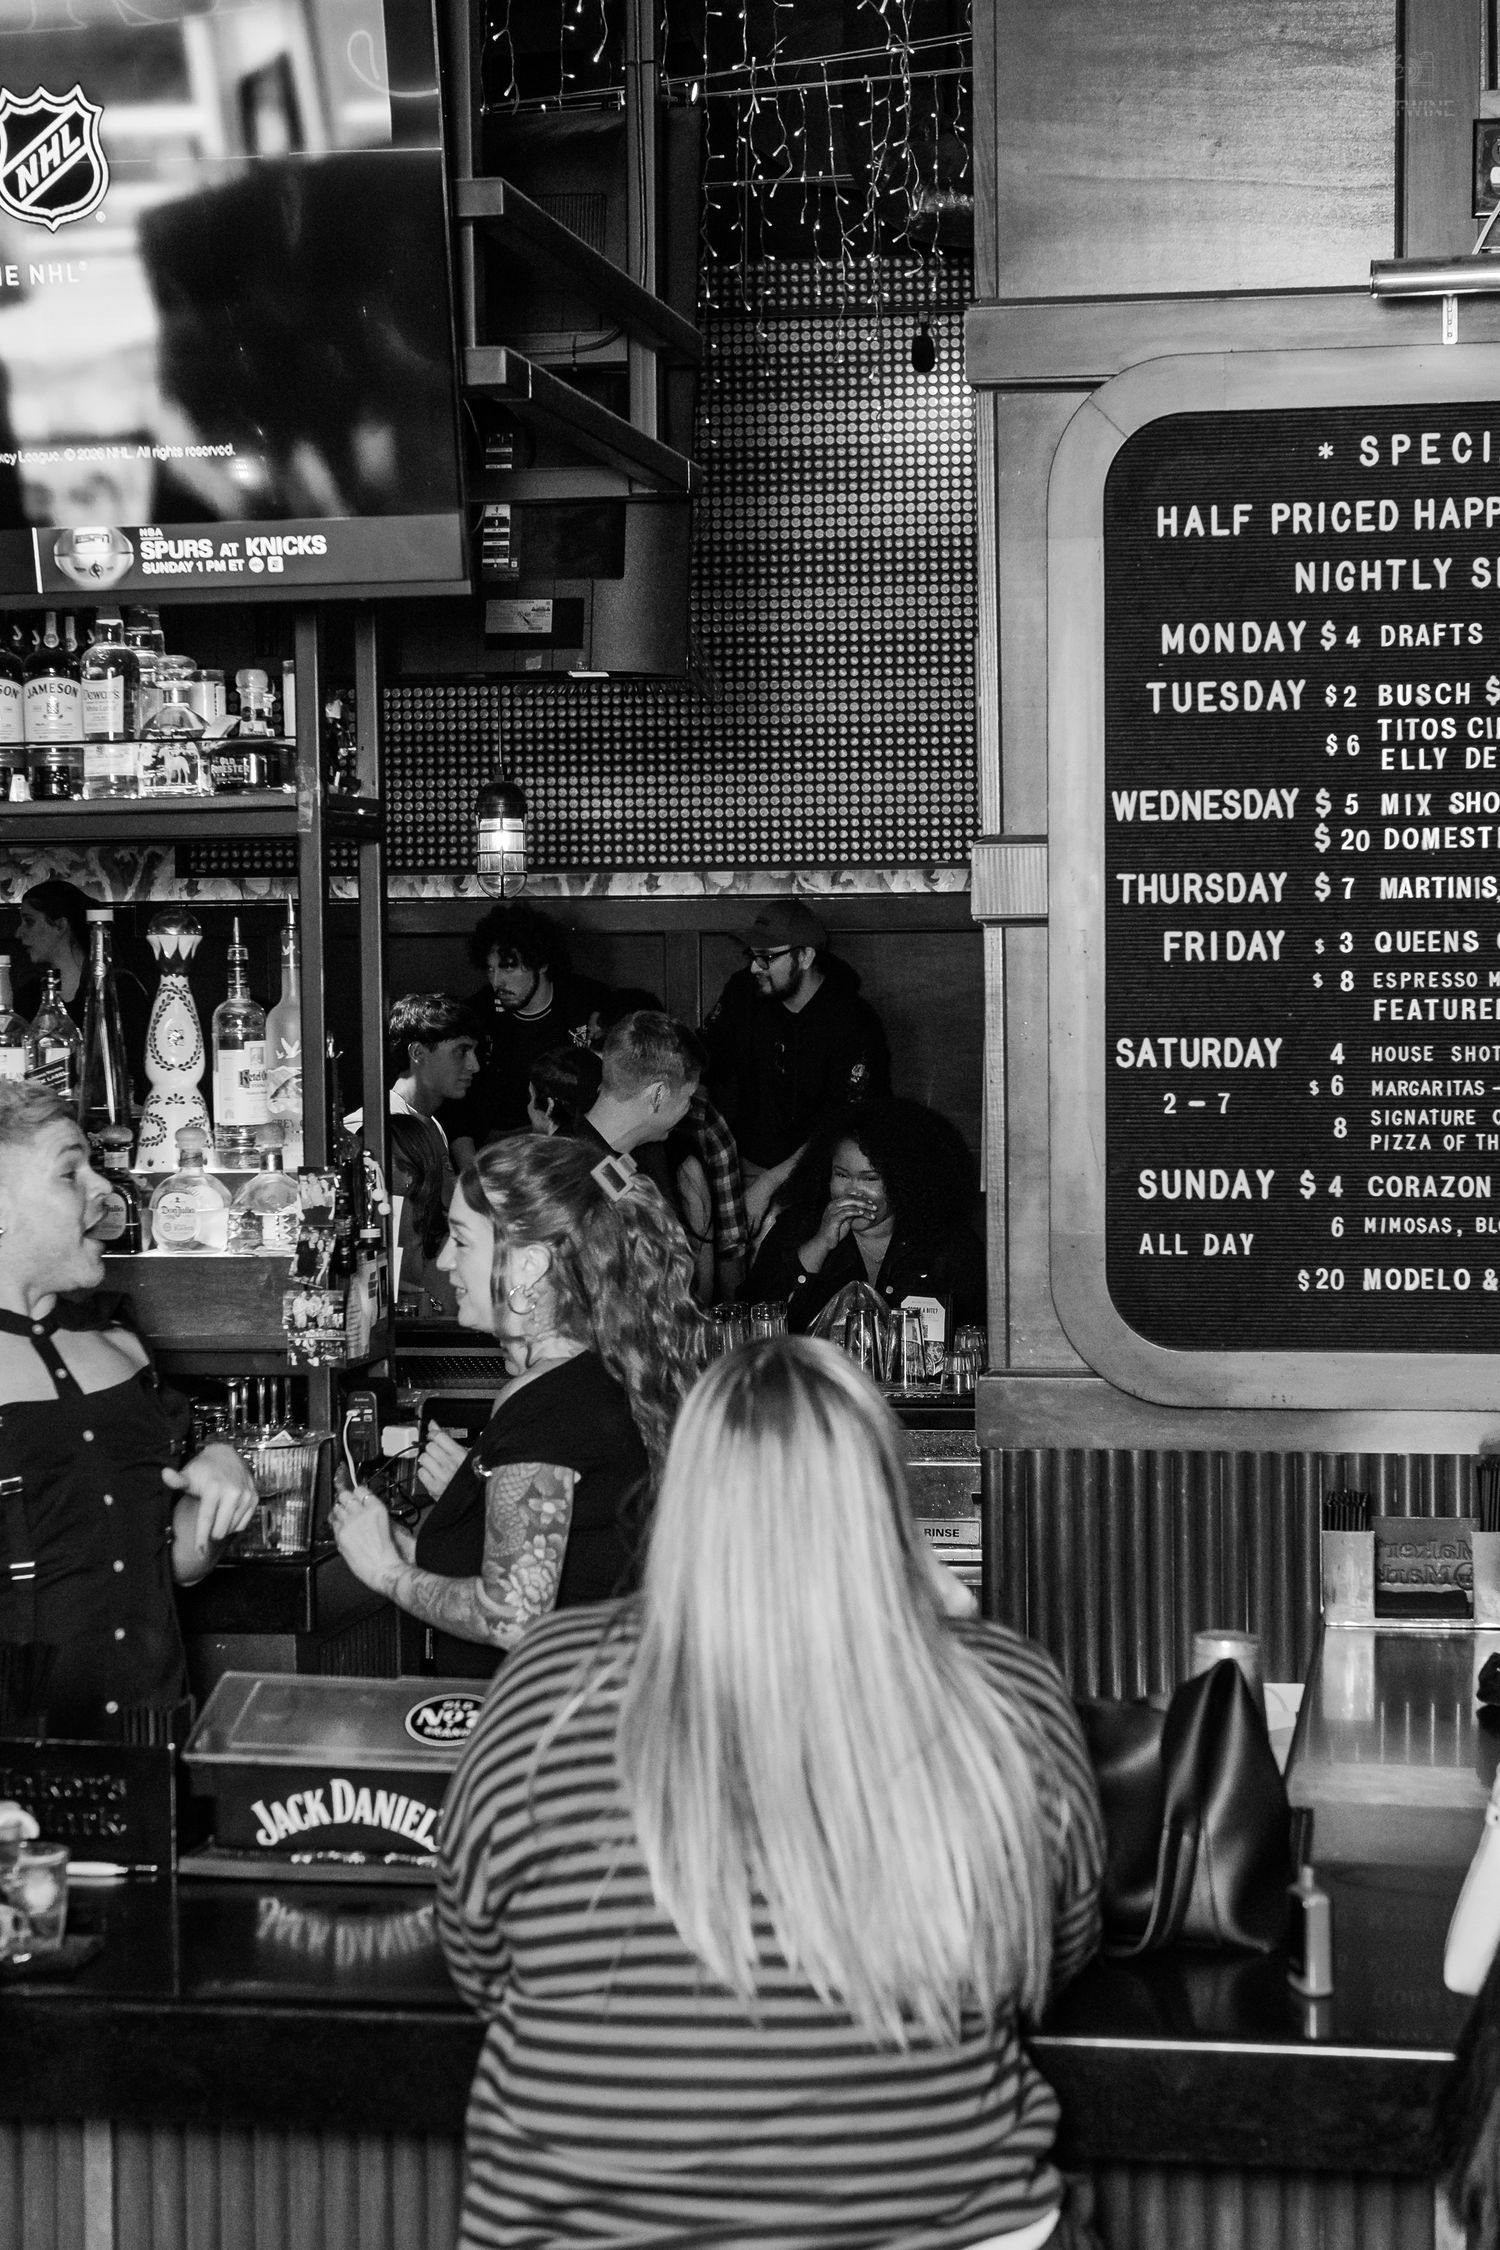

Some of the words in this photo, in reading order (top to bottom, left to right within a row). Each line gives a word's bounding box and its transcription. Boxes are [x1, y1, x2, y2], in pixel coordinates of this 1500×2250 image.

[15, 123, 81, 198] NHL
[136, 445, 151, 458] All
[152, 444, 184, 461] rights
[1360, 431, 1490, 467] SPECI
[1158, 504, 1252, 538] HALF
[1272, 500, 1399, 535] PRICED
[1415, 497, 1500, 530] HAPP
[139, 528, 163, 537] NBA
[140, 538, 213, 560] SPURS
[219, 542, 239, 557] AT
[245, 535, 328, 556] KNICKS
[142, 560, 194, 574] SUNDAY
[196, 560, 203, 572] 1
[205, 559, 227, 572] PM
[228, 559, 245, 572] ET
[1295, 558, 1452, 593] NIGHTLY
[1471, 557, 1500, 588] S
[1162, 620, 1306, 654] MONDAY
[1381, 623, 1483, 647] DRAFTS
[27, 683, 79, 699] JAMESON
[1146, 679, 1305, 714] TUESDAY
[1379, 682, 1470, 706] BUSCH
[1377, 718, 1456, 741] TITOS
[1382, 747, 1447, 770] ELLY
[1466, 747, 1496, 769] DE
[1112, 788, 1299, 821] WEDNESDAY
[1381, 793, 1431, 816] MIX
[1449, 791, 1500, 814] SHO
[1116, 872, 1287, 904] THURSDAY
[1164, 930, 1285, 962] FRIDAY
[1375, 930, 1479, 953] QUEENS
[1374, 972, 1477, 989] ESPRESSO
[1116, 1038, 1282, 1068] SATURDAY
[1330, 1043, 1345, 1064] 4
[1372, 1046, 1433, 1062] HOUSE
[1372, 1080, 1485, 1096] MARGARITAS
[1334, 1117, 1347, 1138] 8
[1371, 1109, 1475, 1126] SIGNATURE
[1371, 1134, 1431, 1151] PIZZA
[1443, 1134, 1466, 1151] OF
[1138, 1169, 1274, 1199] SUNDAY
[1368, 1175, 1490, 1198] CORAZON
[1332, 1217, 1344, 1237] 6
[1365, 1217, 1462, 1237] MIMOSAS,
[1476, 1217, 1500, 1233] BL
[1139, 1233, 1188, 1255] ALL
[1204, 1233, 1253, 1256] DAY
[1363, 1268, 1470, 1291] MODELO
[923, 1527, 960, 1538] RINSE
[251, 1789, 332, 1846] JACK
